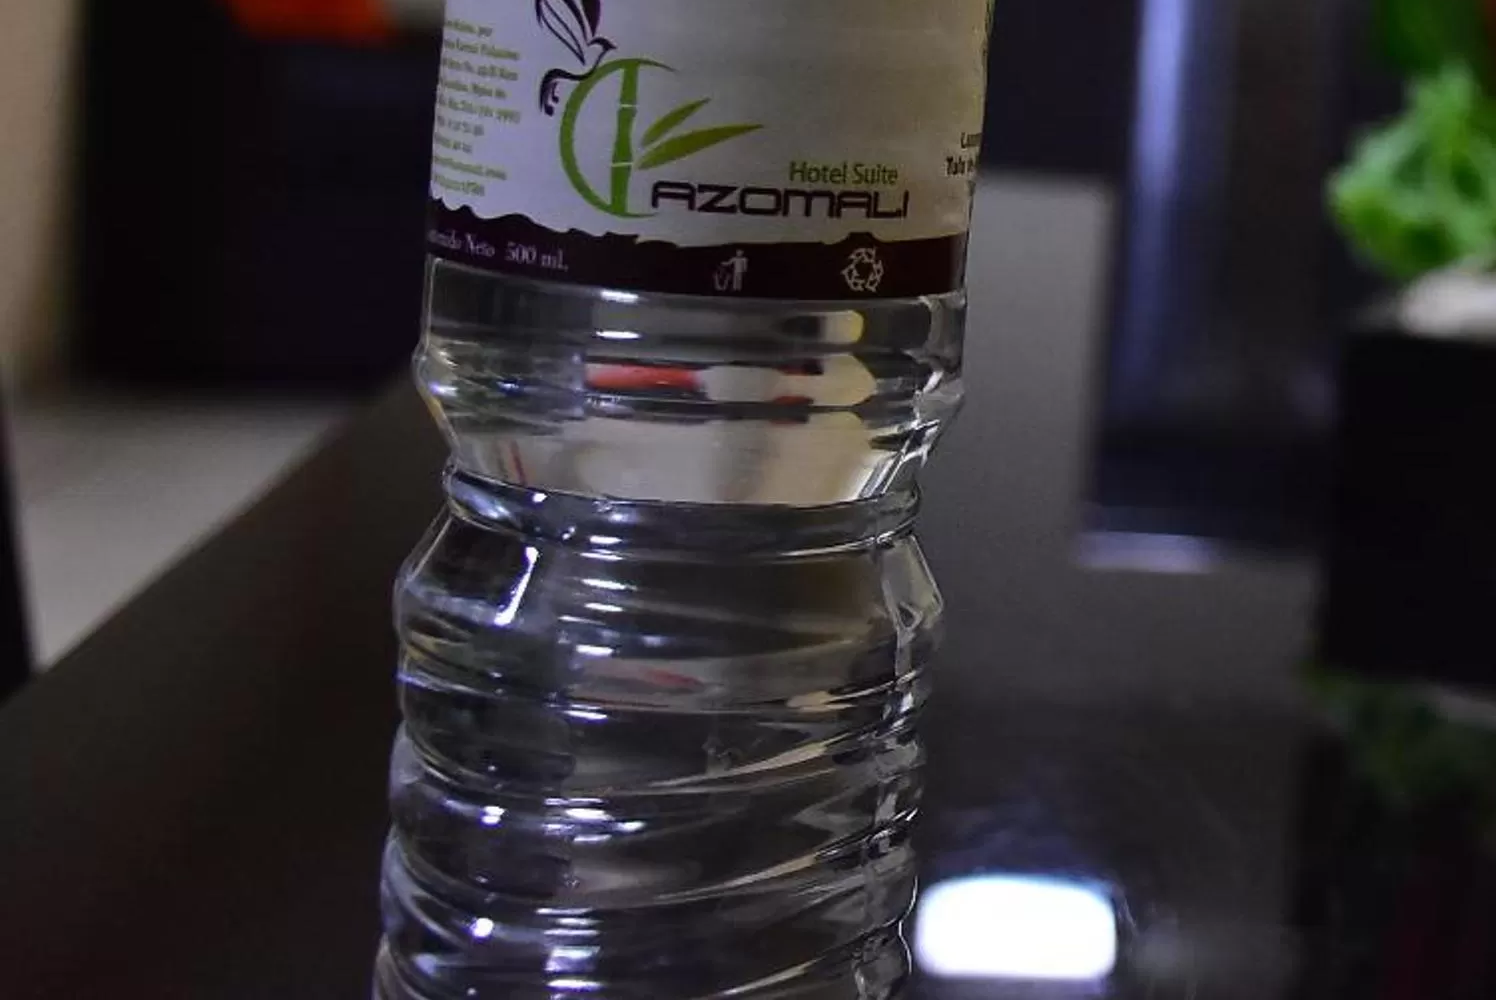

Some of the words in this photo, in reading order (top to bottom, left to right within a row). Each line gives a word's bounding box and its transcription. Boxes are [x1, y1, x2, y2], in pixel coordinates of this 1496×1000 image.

[788, 161, 847, 184] Hotel
[852, 164, 898, 186] Suite
[652, 180, 909, 219] AZOMALI
[465, 232, 496, 258] Neto
[505, 241, 537, 264] 500
